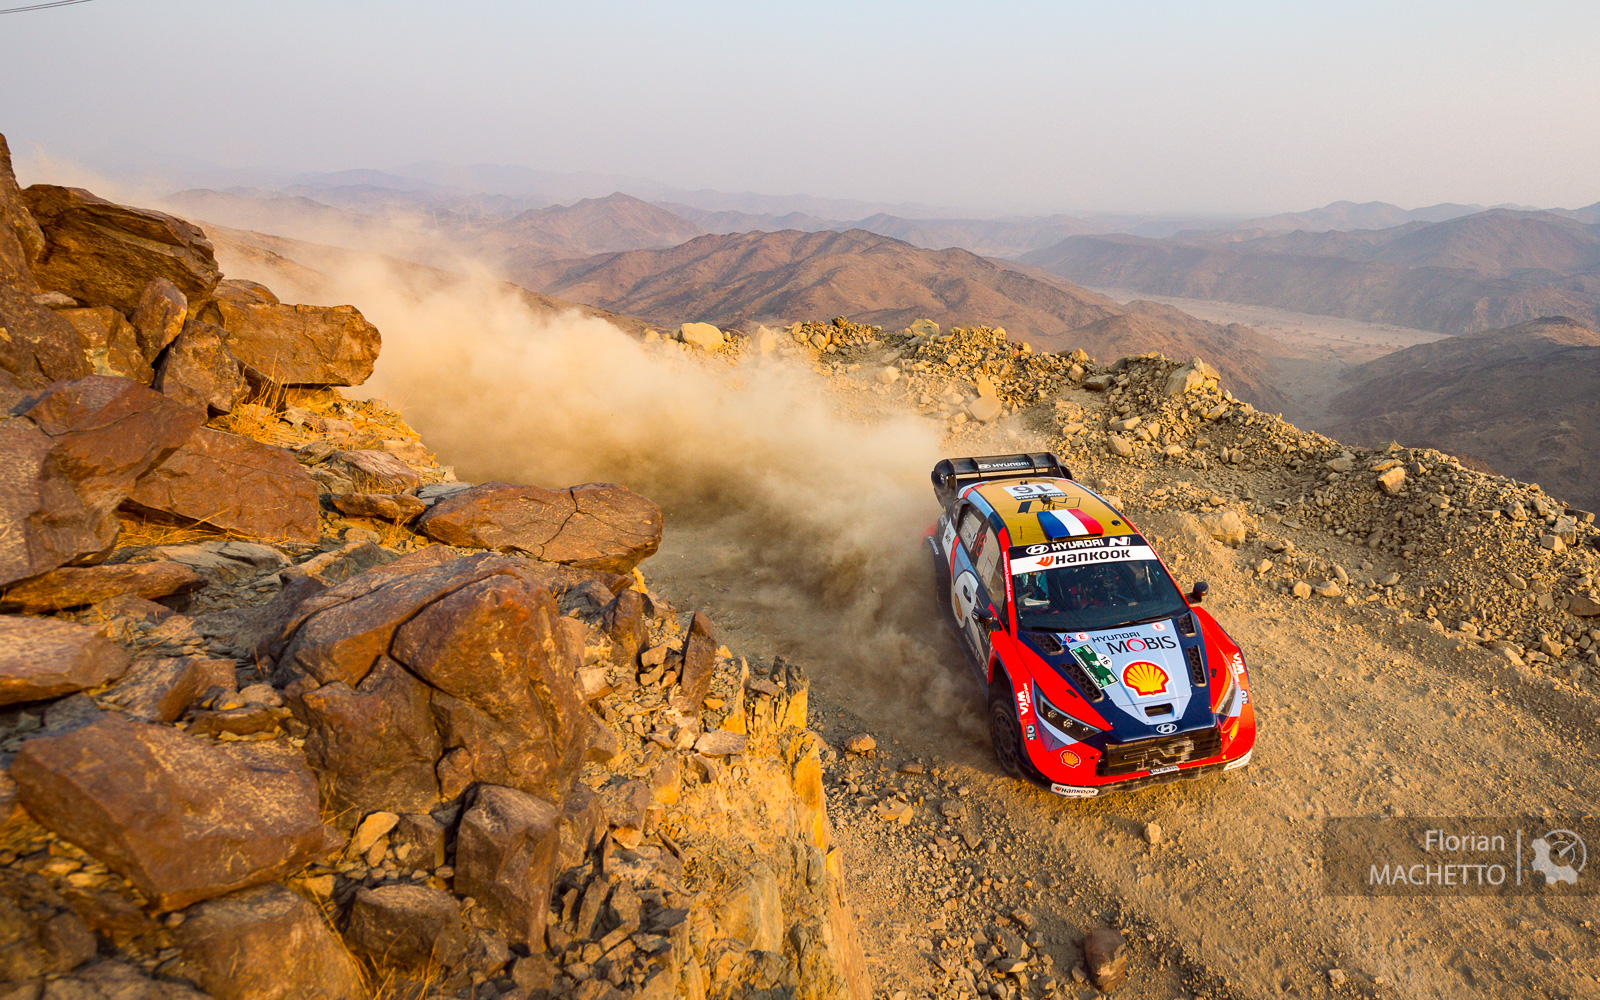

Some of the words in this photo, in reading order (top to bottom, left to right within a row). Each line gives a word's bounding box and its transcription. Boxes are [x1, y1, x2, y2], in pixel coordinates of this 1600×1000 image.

[1013, 485, 1053, 494] 16
[971, 531, 987, 557] 16
[1052, 539, 1104, 551] HYUNDAI
[1092, 631, 1140, 643] HYUNDAI
[1105, 635, 1177, 655] MOBIS
[1100, 656, 1110, 666] 16
